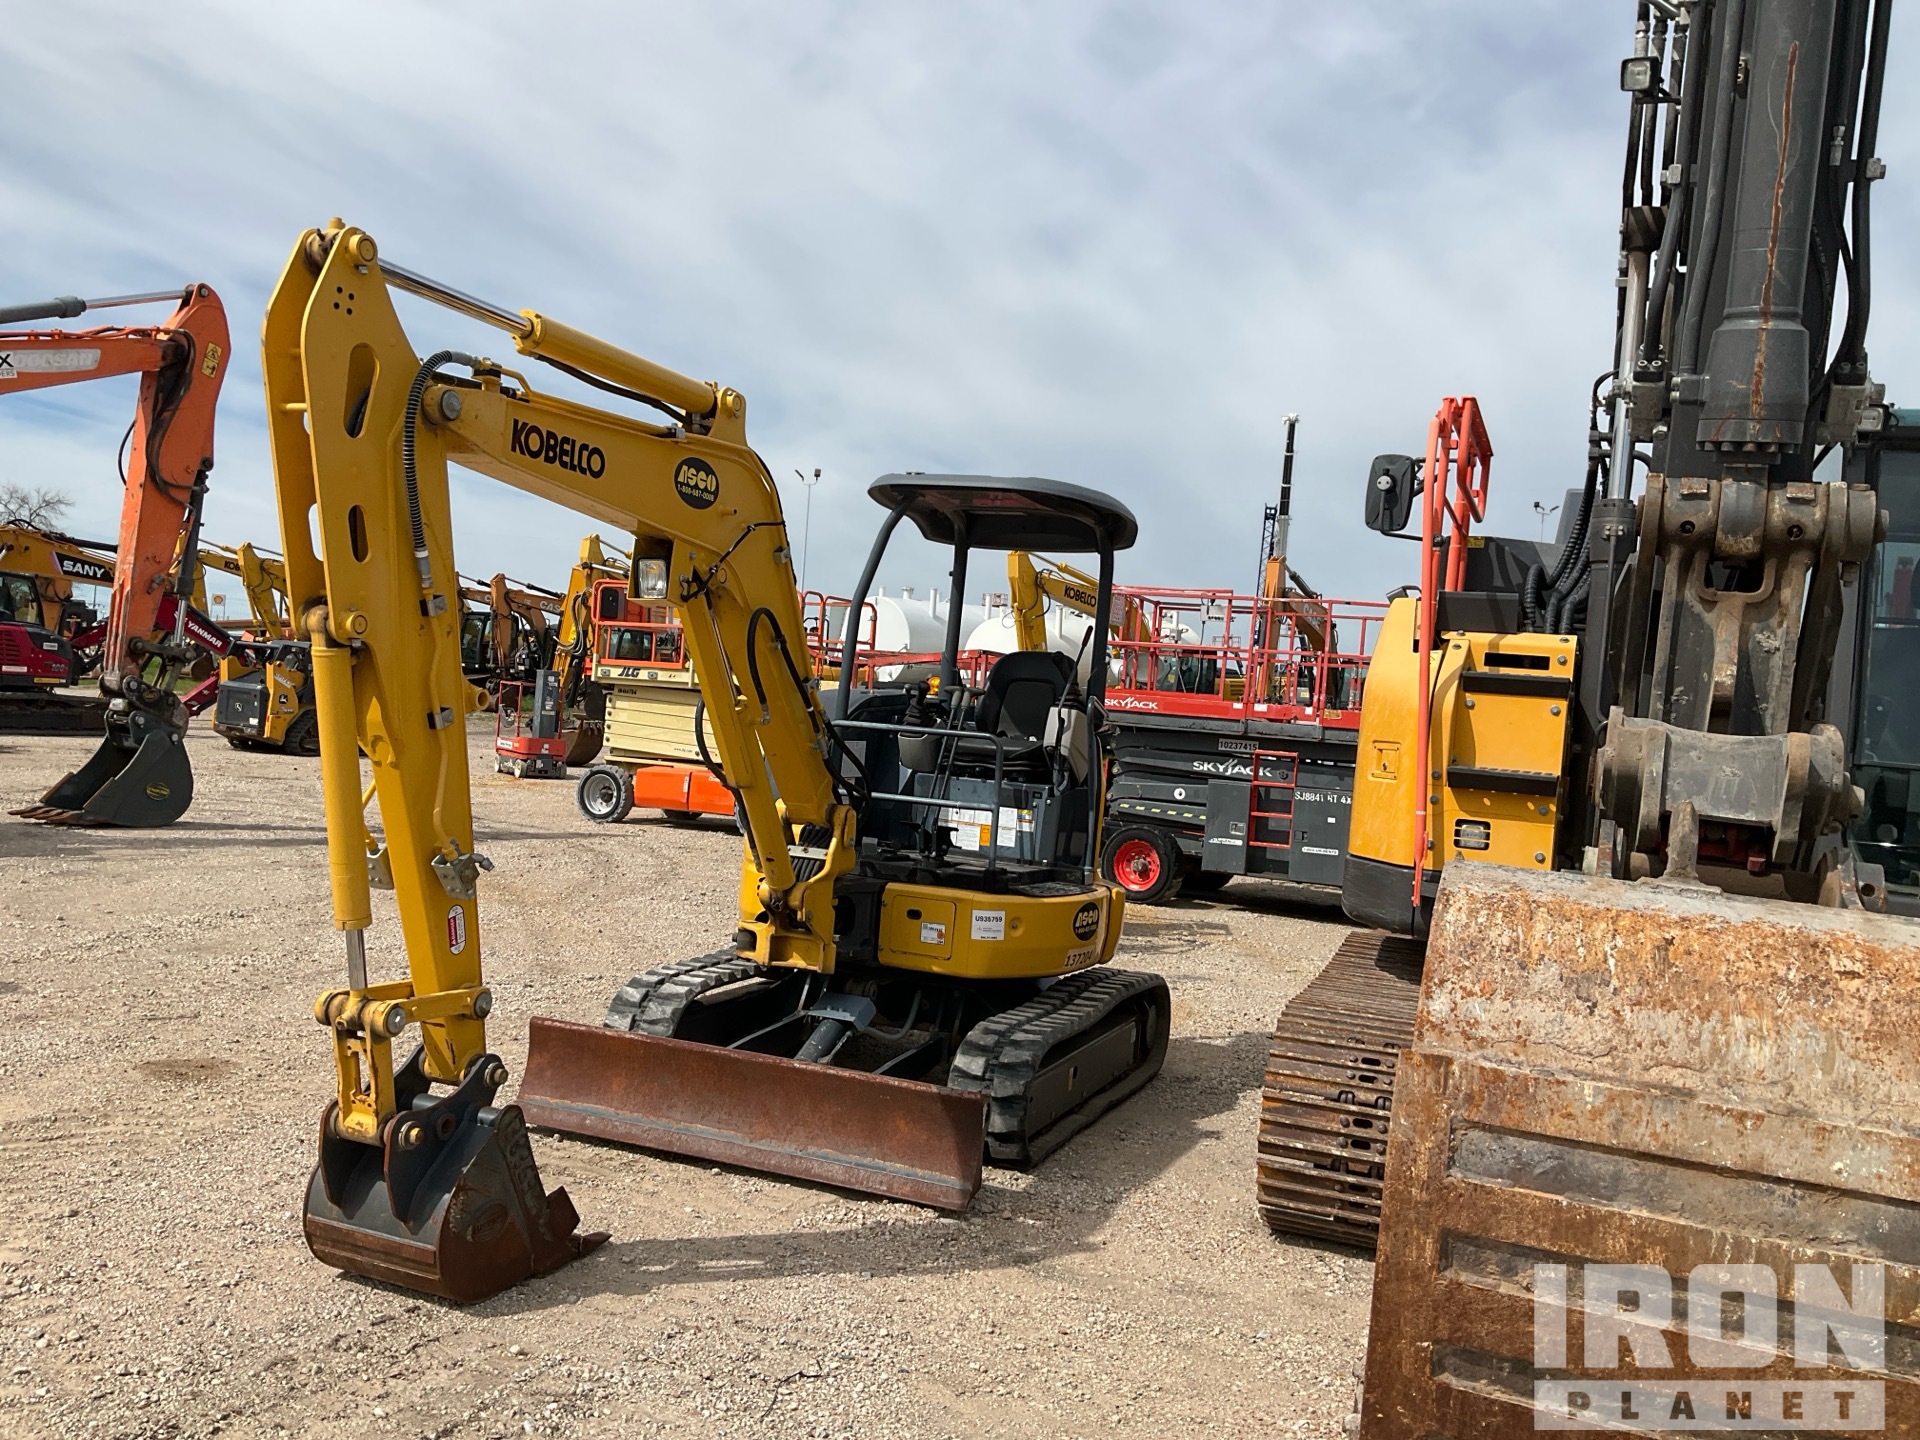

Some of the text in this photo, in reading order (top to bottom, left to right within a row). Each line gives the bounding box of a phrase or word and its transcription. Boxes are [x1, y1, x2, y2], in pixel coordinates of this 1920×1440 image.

[511, 418, 605, 479] KOBELCO
[677, 464, 717, 492] ASCO
[62, 560, 105, 578] SANY
[1064, 585, 1097, 608] KOBELCO
[187, 620, 223, 648] YANMAR
[617, 666, 642, 678] JLG
[1104, 696, 1158, 710] SKYJACK
[1219, 741, 1257, 751] 10237415
[1192, 758, 1272, 777] SKYJACK
[1075, 909, 1099, 928] ASCO
